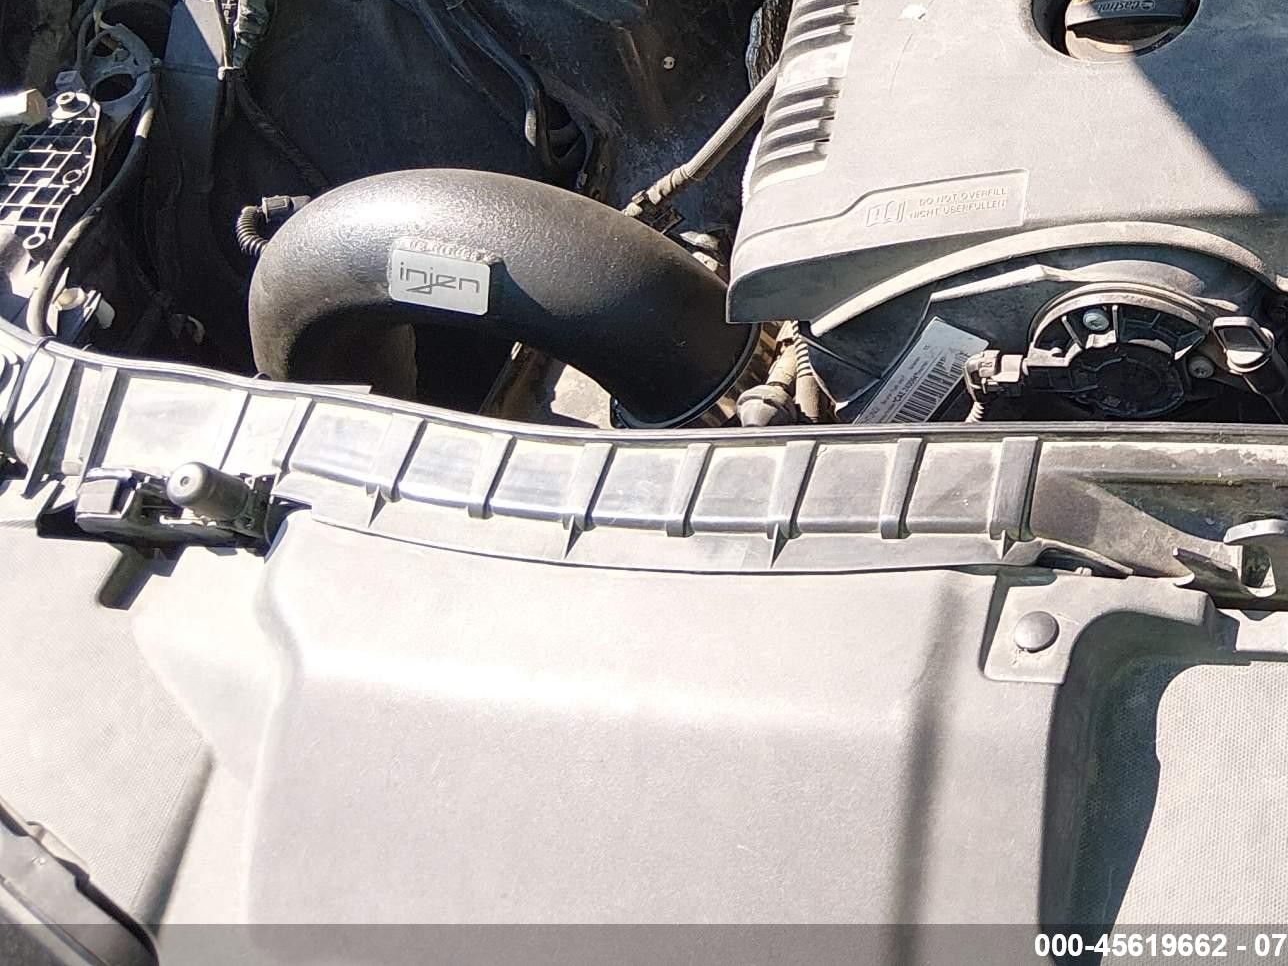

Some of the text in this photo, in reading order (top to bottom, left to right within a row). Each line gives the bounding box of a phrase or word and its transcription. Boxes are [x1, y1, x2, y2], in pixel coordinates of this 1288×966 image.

[919, 187, 1007, 207] DO NOT OVERFILL
[400, 261, 480, 295] injen
